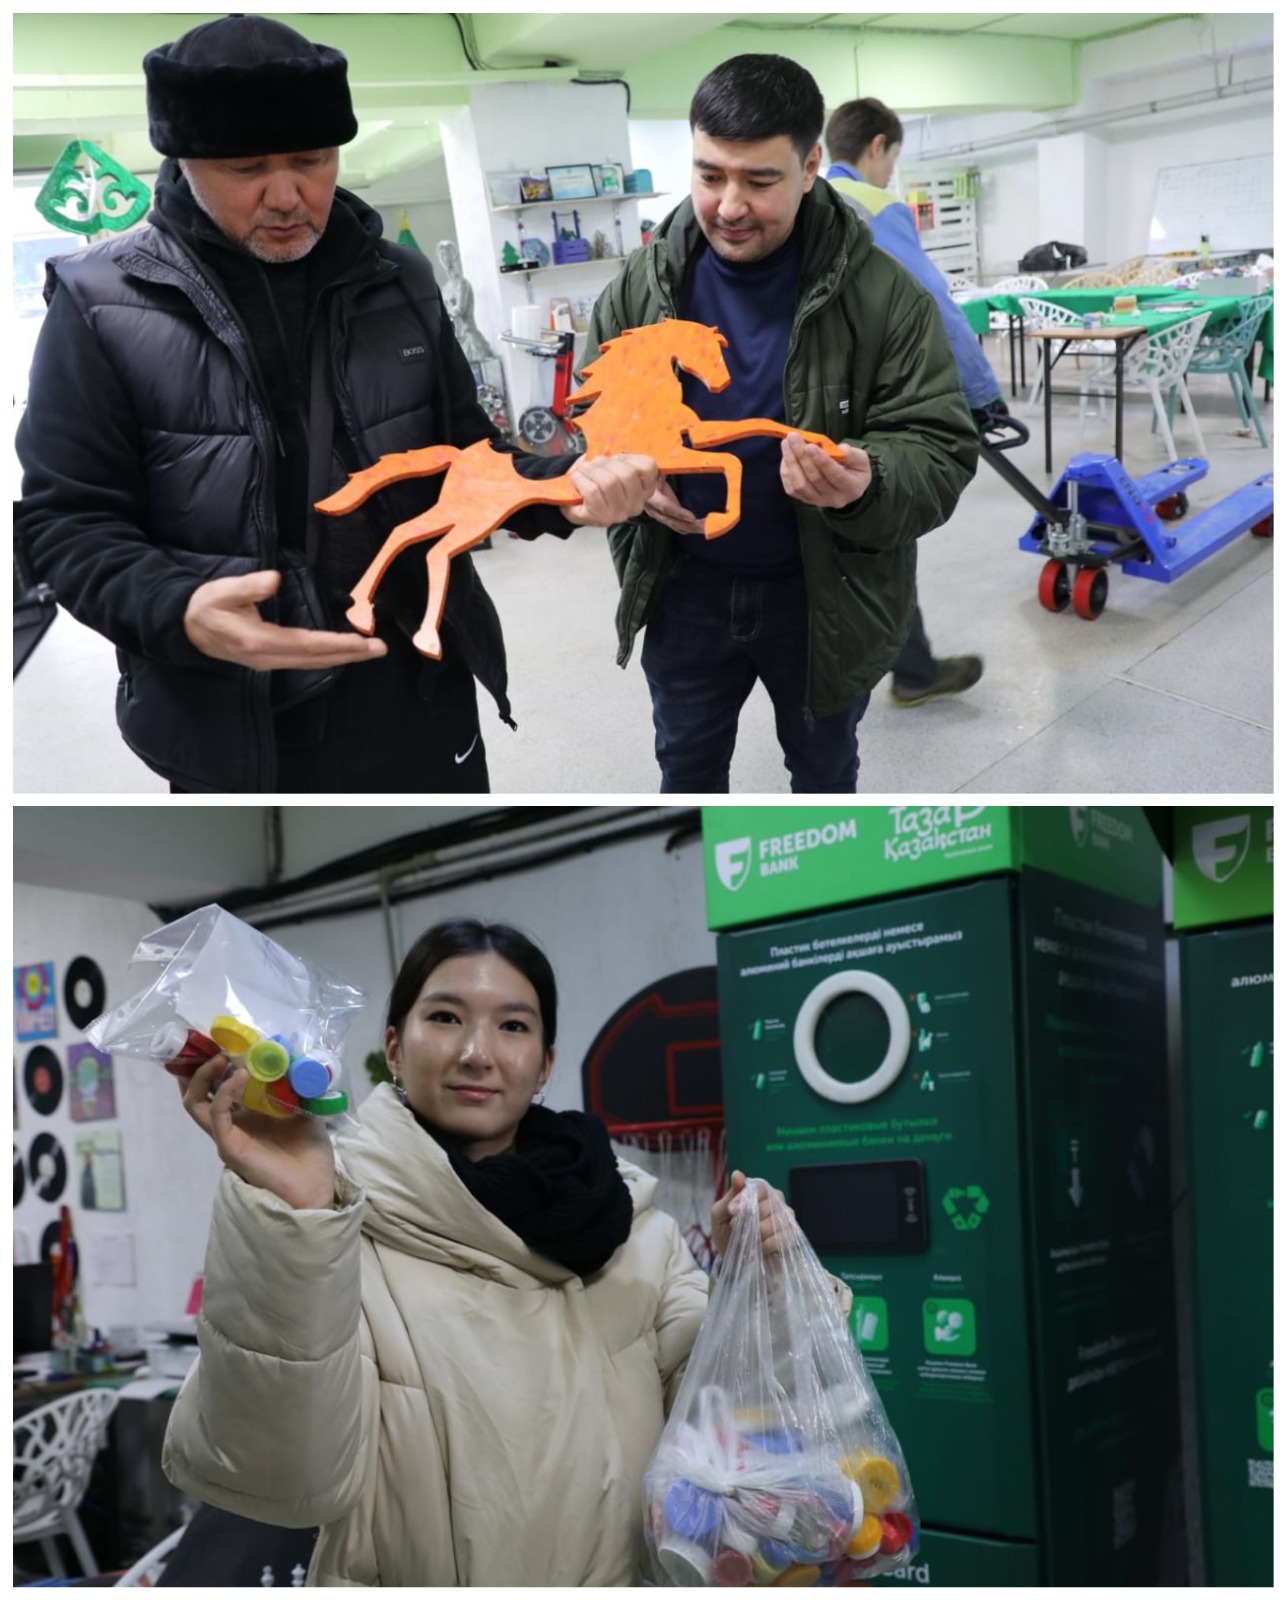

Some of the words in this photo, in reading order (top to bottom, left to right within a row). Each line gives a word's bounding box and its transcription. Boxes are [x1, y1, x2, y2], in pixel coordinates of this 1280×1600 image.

[759, 819, 857, 860] FREEDOM
[760, 856, 798, 877] BANK
[883, 1563, 931, 1584] ard
